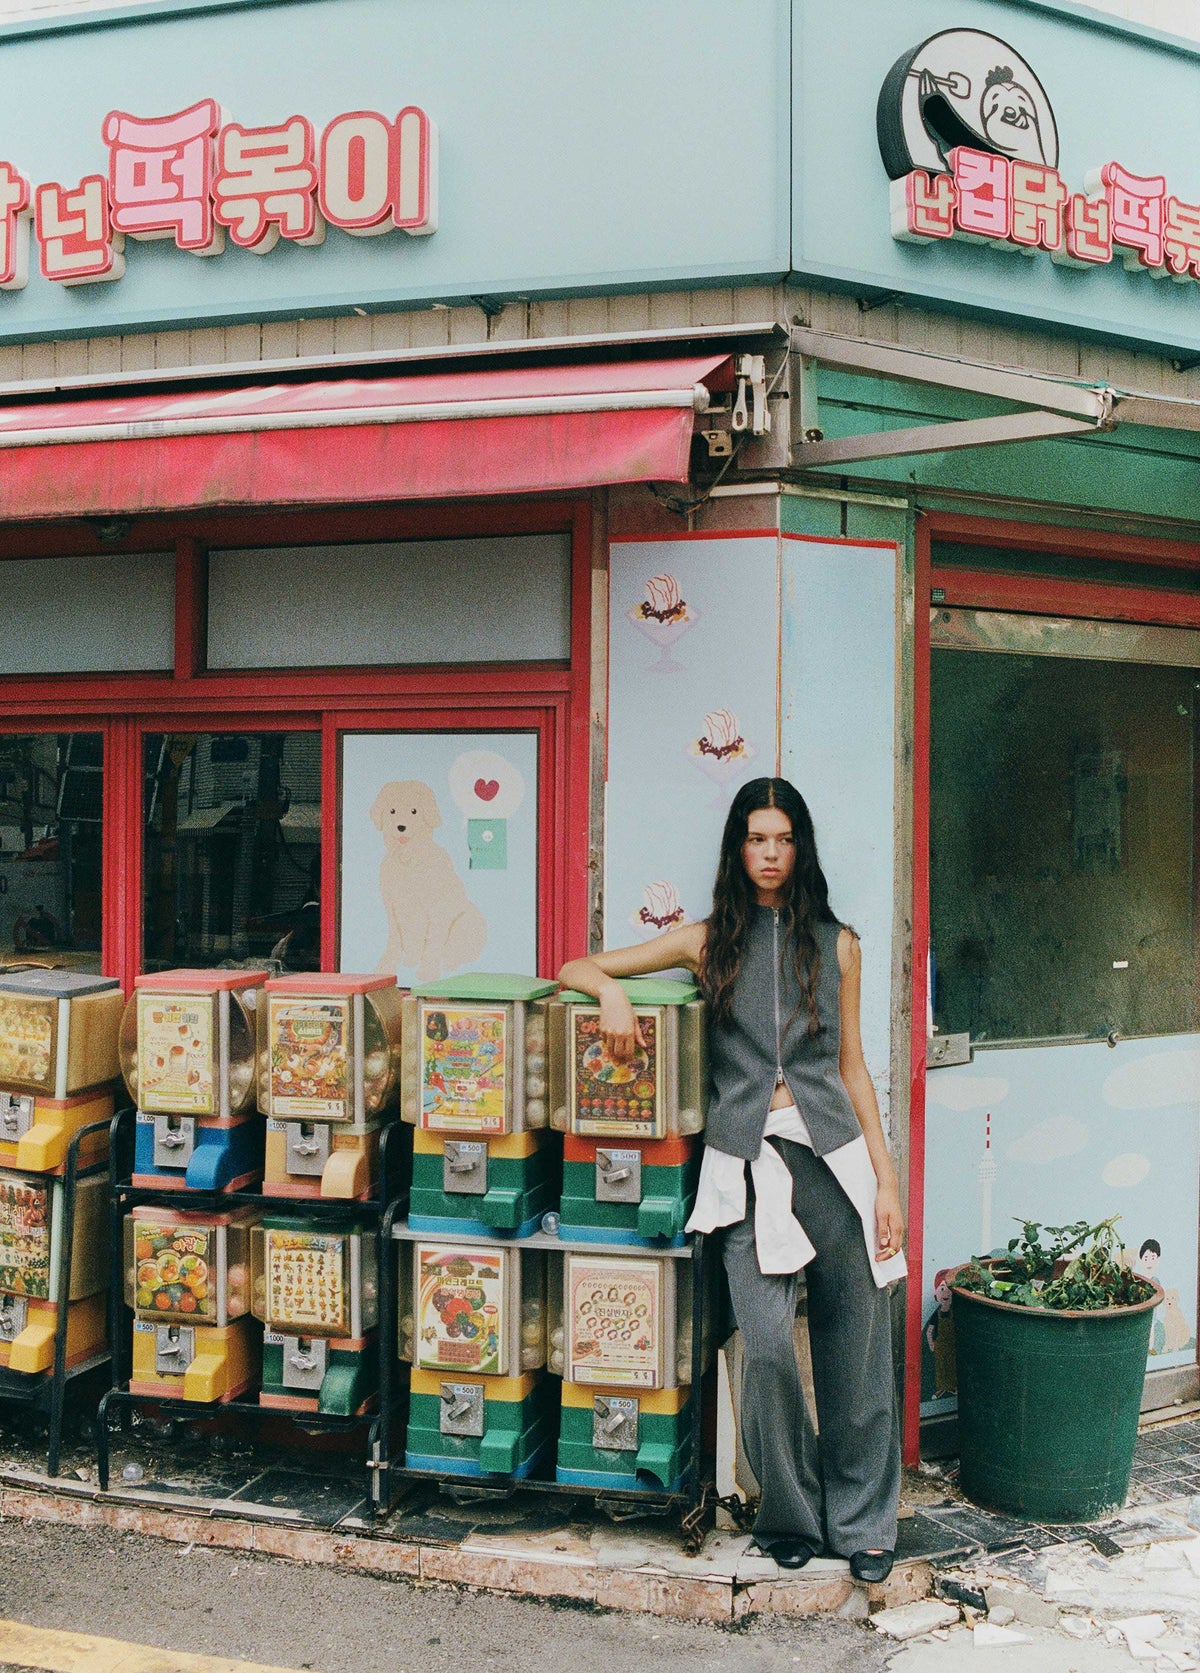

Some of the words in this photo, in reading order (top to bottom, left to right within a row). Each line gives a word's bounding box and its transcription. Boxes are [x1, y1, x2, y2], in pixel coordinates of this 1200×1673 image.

[142, 1323, 153, 1331] 500
[462, 1386, 474, 1394] 500
[618, 1400, 631, 1408] 500
